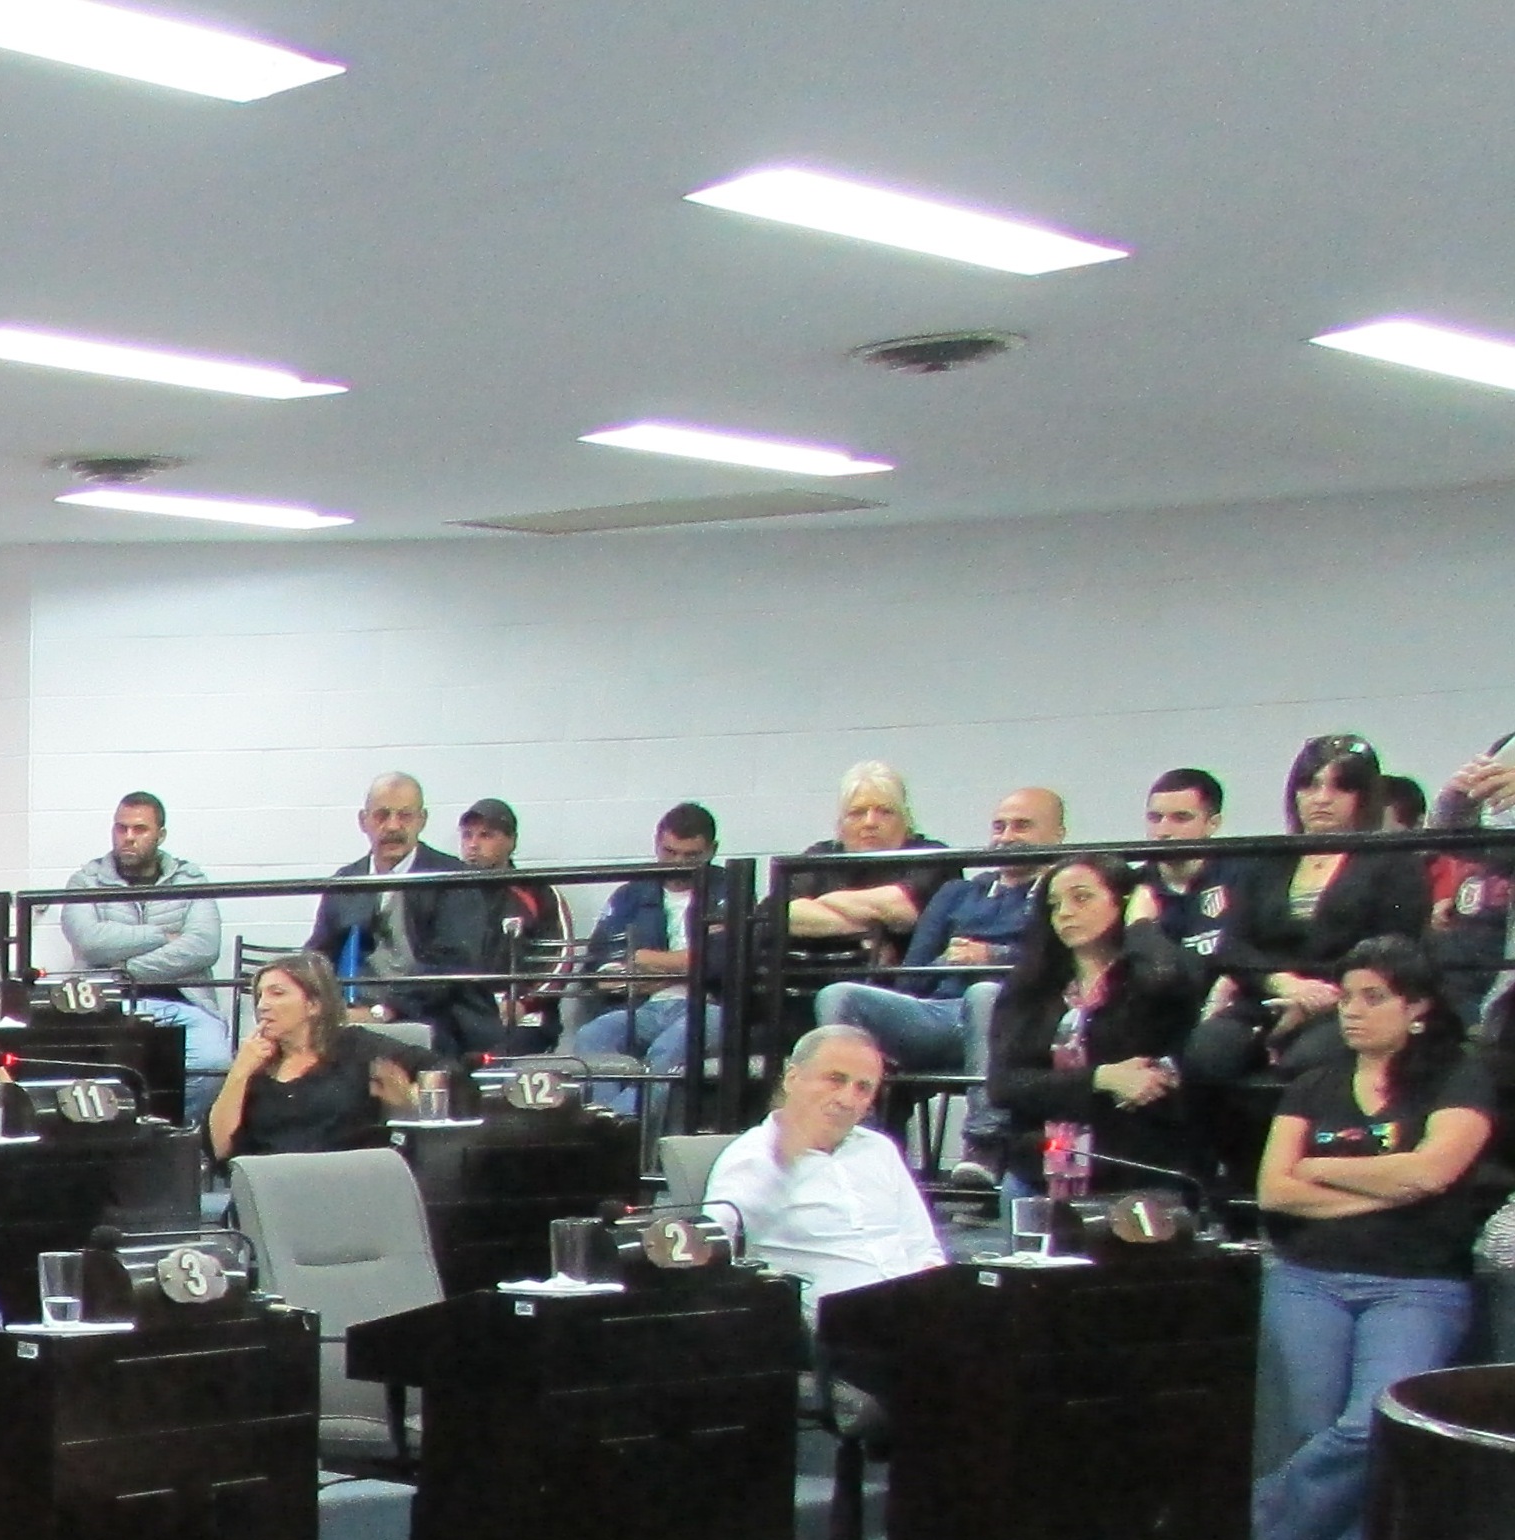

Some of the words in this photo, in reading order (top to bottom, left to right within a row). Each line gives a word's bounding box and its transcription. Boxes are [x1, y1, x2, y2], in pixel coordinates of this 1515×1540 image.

[62, 982, 96, 1009] 18
[72, 1086, 104, 1117] 11
[518, 1073, 553, 1104] 12
[1132, 1202, 1153, 1236] 1
[665, 1223, 693, 1261] 2
[181, 1254, 207, 1295] 3
